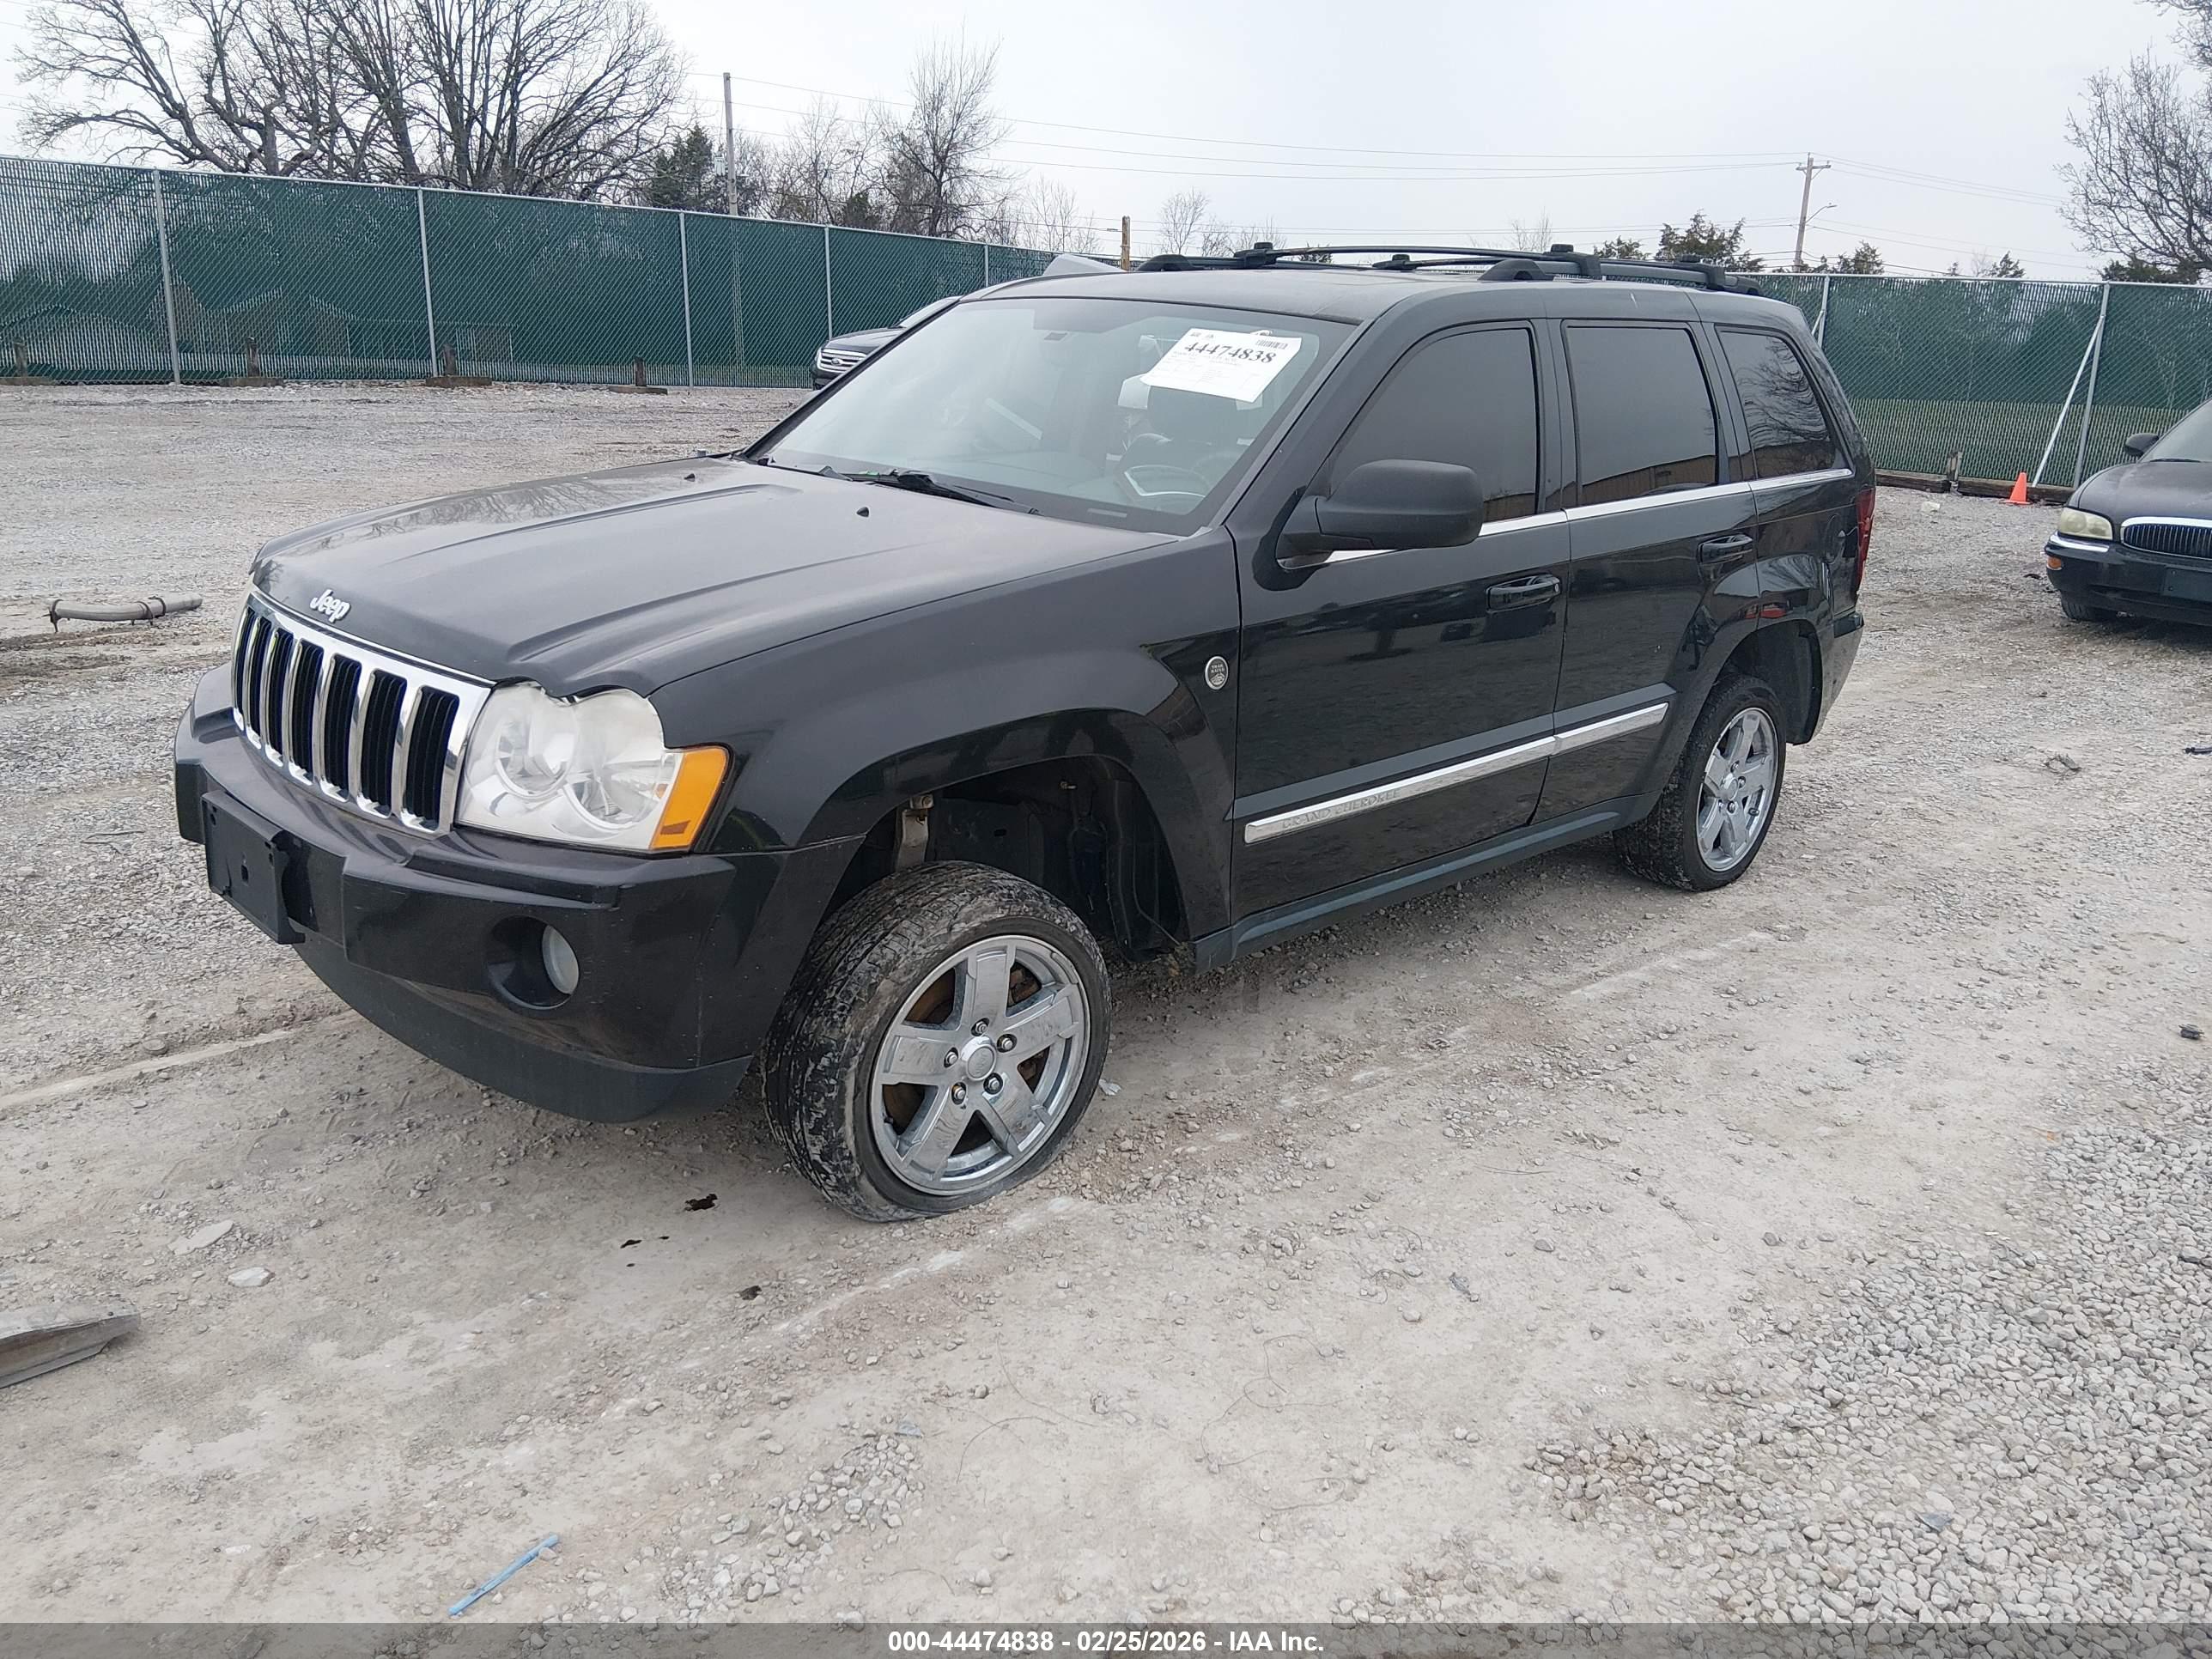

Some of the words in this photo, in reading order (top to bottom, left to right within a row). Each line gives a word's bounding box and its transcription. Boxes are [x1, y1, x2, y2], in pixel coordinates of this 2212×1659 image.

[1184, 342, 1277, 363] 44474838
[310, 589, 351, 623] Jeep
[1282, 808, 1332, 829] GRAND
